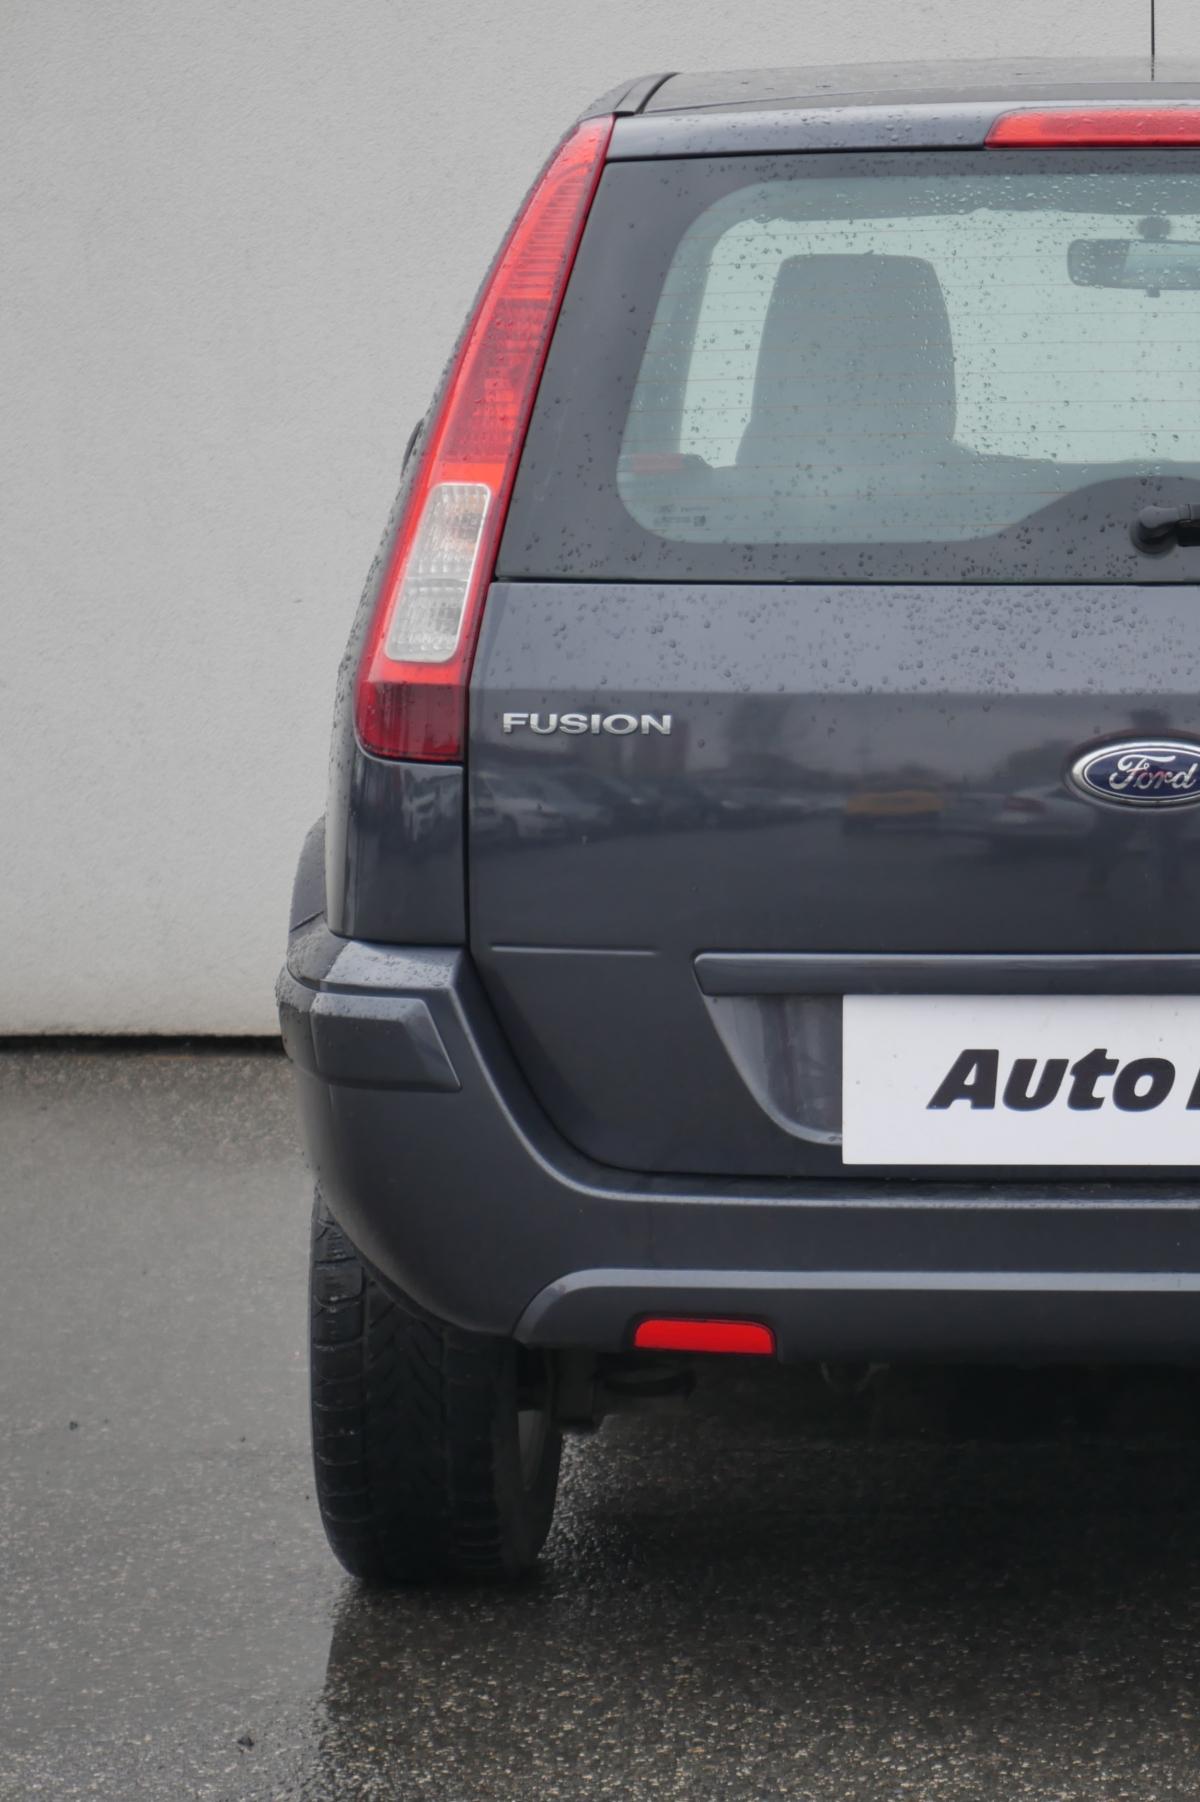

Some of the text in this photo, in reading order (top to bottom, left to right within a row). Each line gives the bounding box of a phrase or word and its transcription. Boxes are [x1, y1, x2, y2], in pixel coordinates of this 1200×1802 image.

[502, 712, 672, 735] FUSION
[1108, 754, 1198, 790] Ford
[926, 1048, 1177, 1112] Auto
